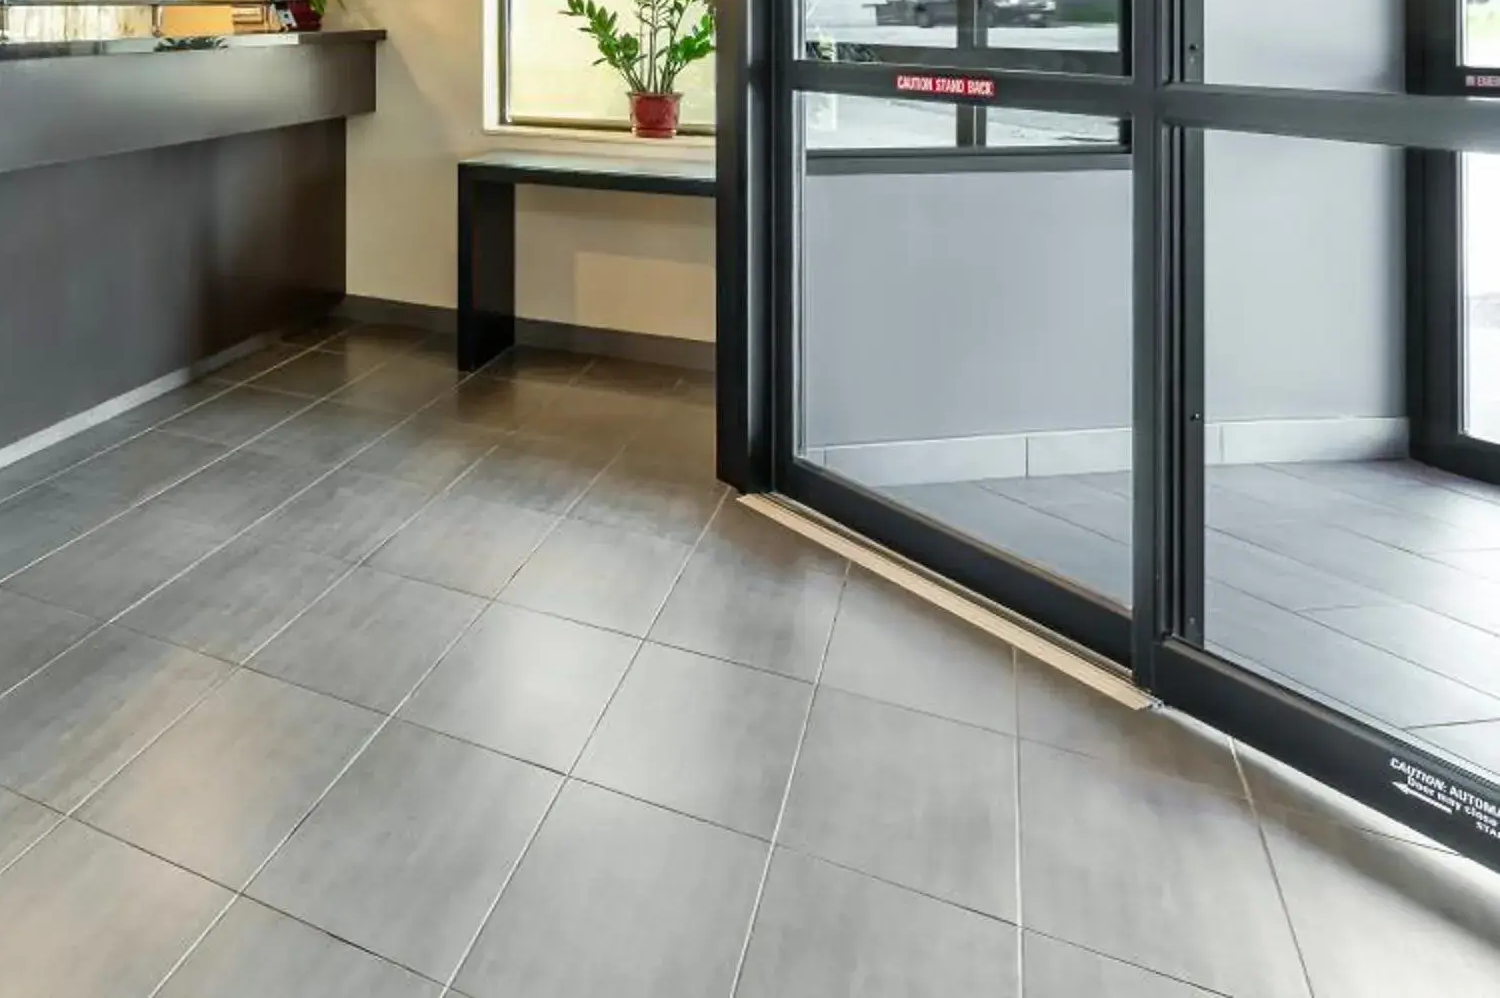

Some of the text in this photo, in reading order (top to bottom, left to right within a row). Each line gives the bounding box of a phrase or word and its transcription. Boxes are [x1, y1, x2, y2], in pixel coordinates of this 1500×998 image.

[896, 75, 995, 96] CAUTION STAND BACK
[1390, 757, 1448, 793] CAUTION:
[1437, 792, 1461, 811] may
[1464, 805, 1498, 827] close
